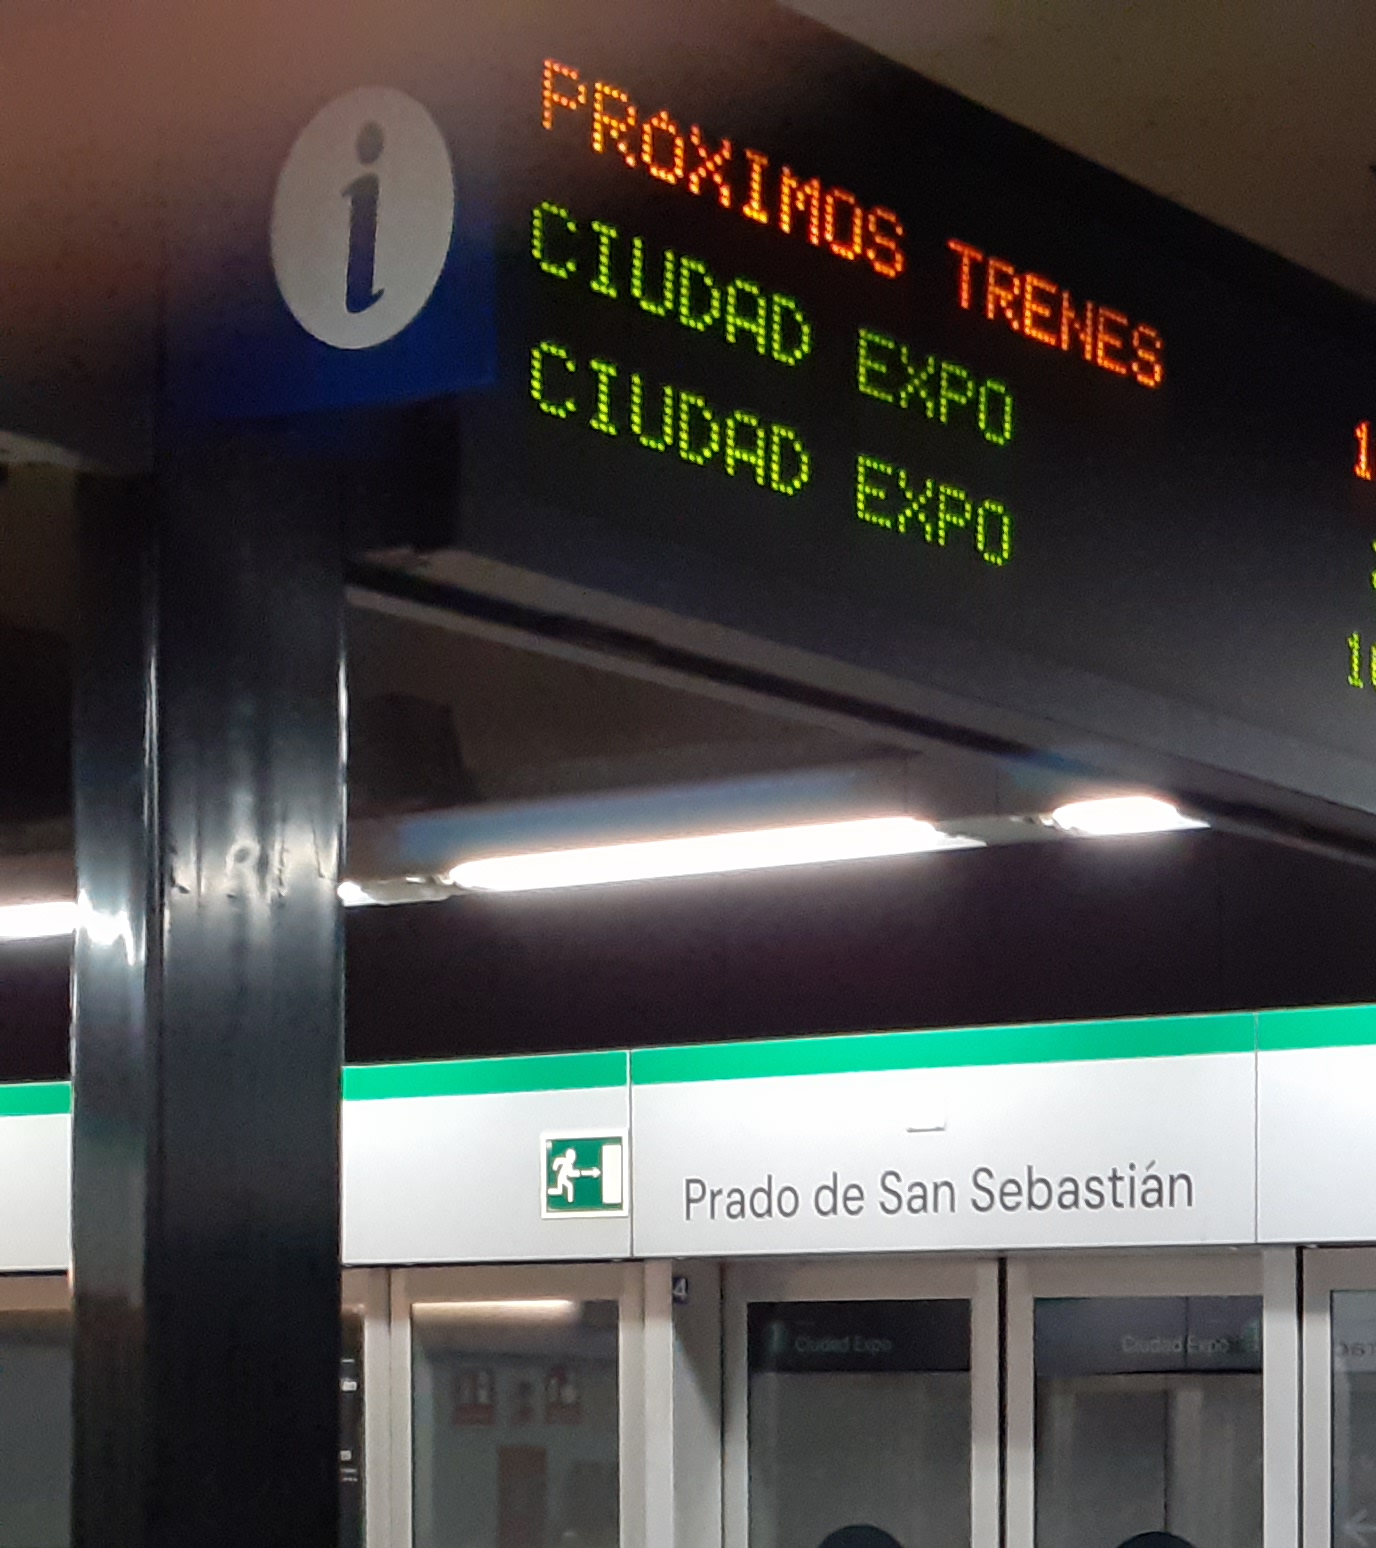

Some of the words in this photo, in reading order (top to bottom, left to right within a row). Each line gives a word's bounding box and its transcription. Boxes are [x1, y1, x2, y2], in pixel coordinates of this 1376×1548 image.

[531, 201, 812, 367] CIUDAD
[858, 328, 1014, 447] EXPO
[947, 237, 1166, 390] TRENES
[530, 340, 810, 497] CIUDAD
[855, 453, 1014, 567] EXPO
[683, 1174, 800, 1222] Prado
[813, 1170, 866, 1217] de
[879, 1168, 956, 1215] San
[971, 1158, 1195, 1212] Sebastián
[673, 1278, 687, 1300] 4
